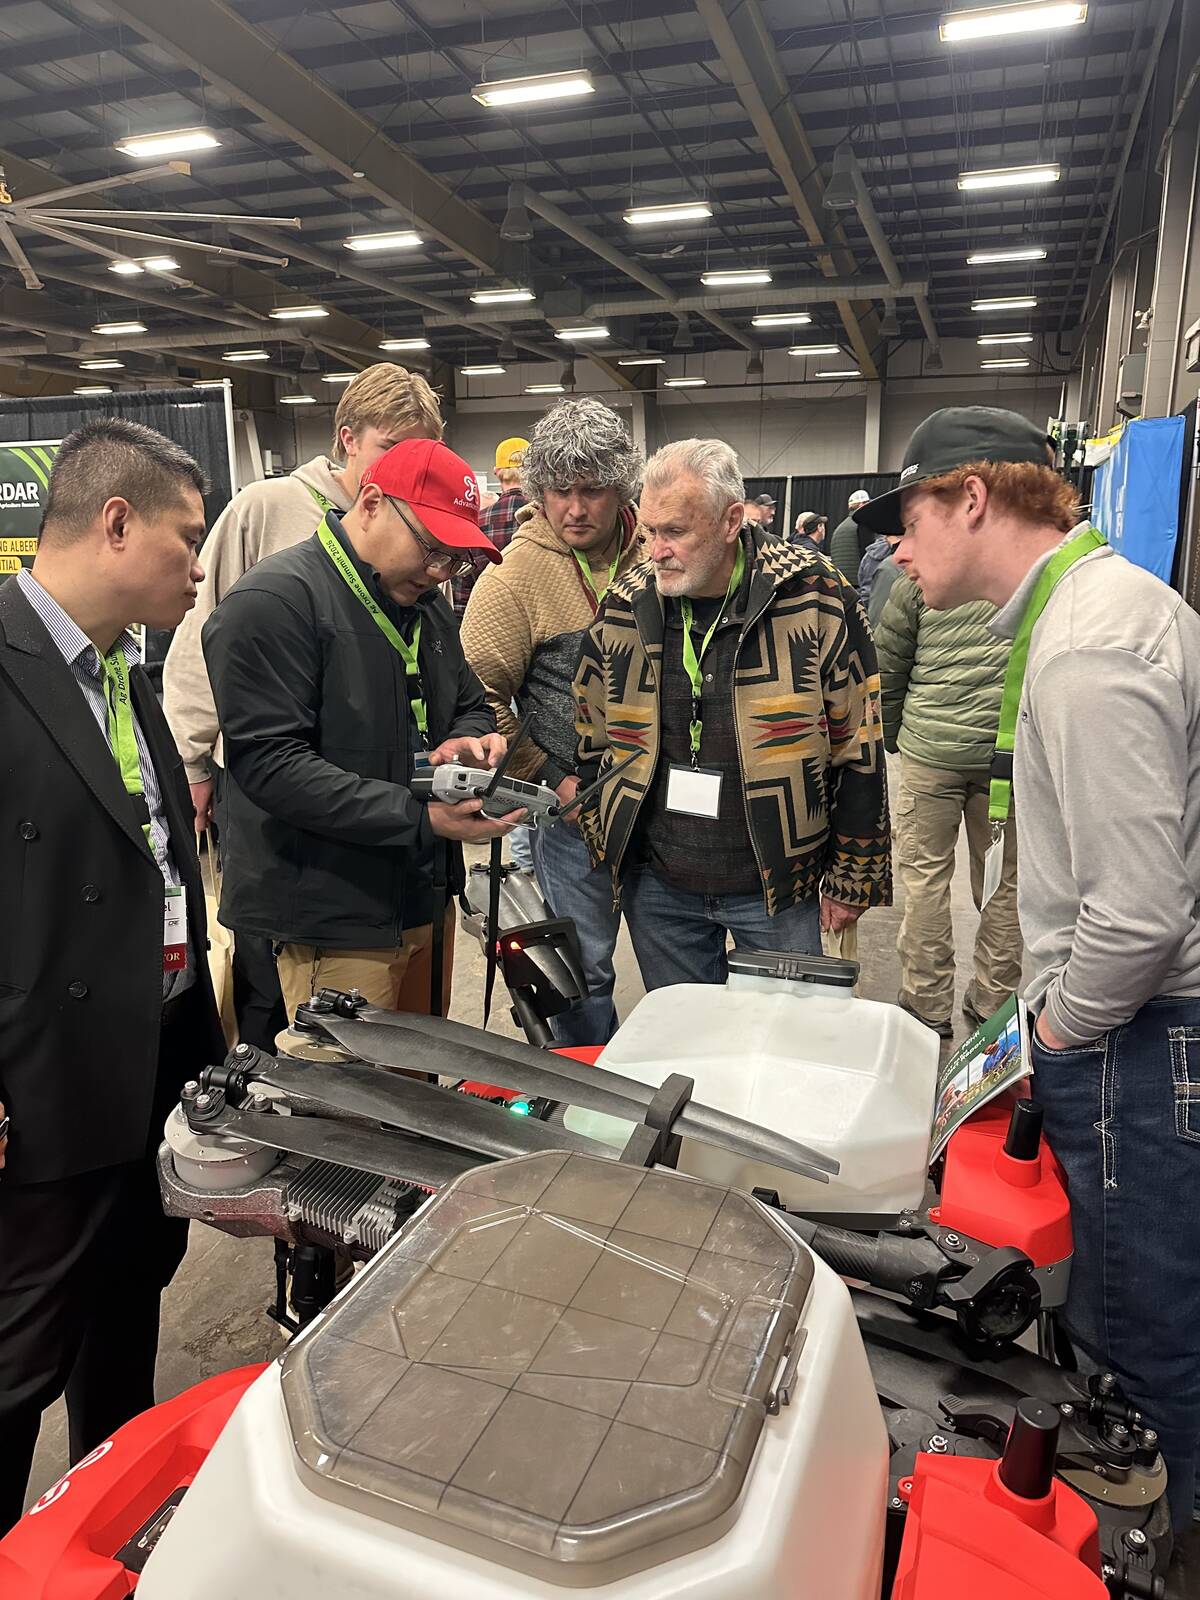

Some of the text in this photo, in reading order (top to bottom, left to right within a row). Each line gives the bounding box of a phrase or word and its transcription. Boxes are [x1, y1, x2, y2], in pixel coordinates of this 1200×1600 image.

[0, 483, 40, 500] DAR
[0, 560, 18, 570] TIAL
[337, 555, 356, 584] Summit
[354, 584, 371, 605] Drone
[370, 604, 379, 614] Ag
[114, 667, 126, 690] Drone
[119, 692, 128, 705] Ag
